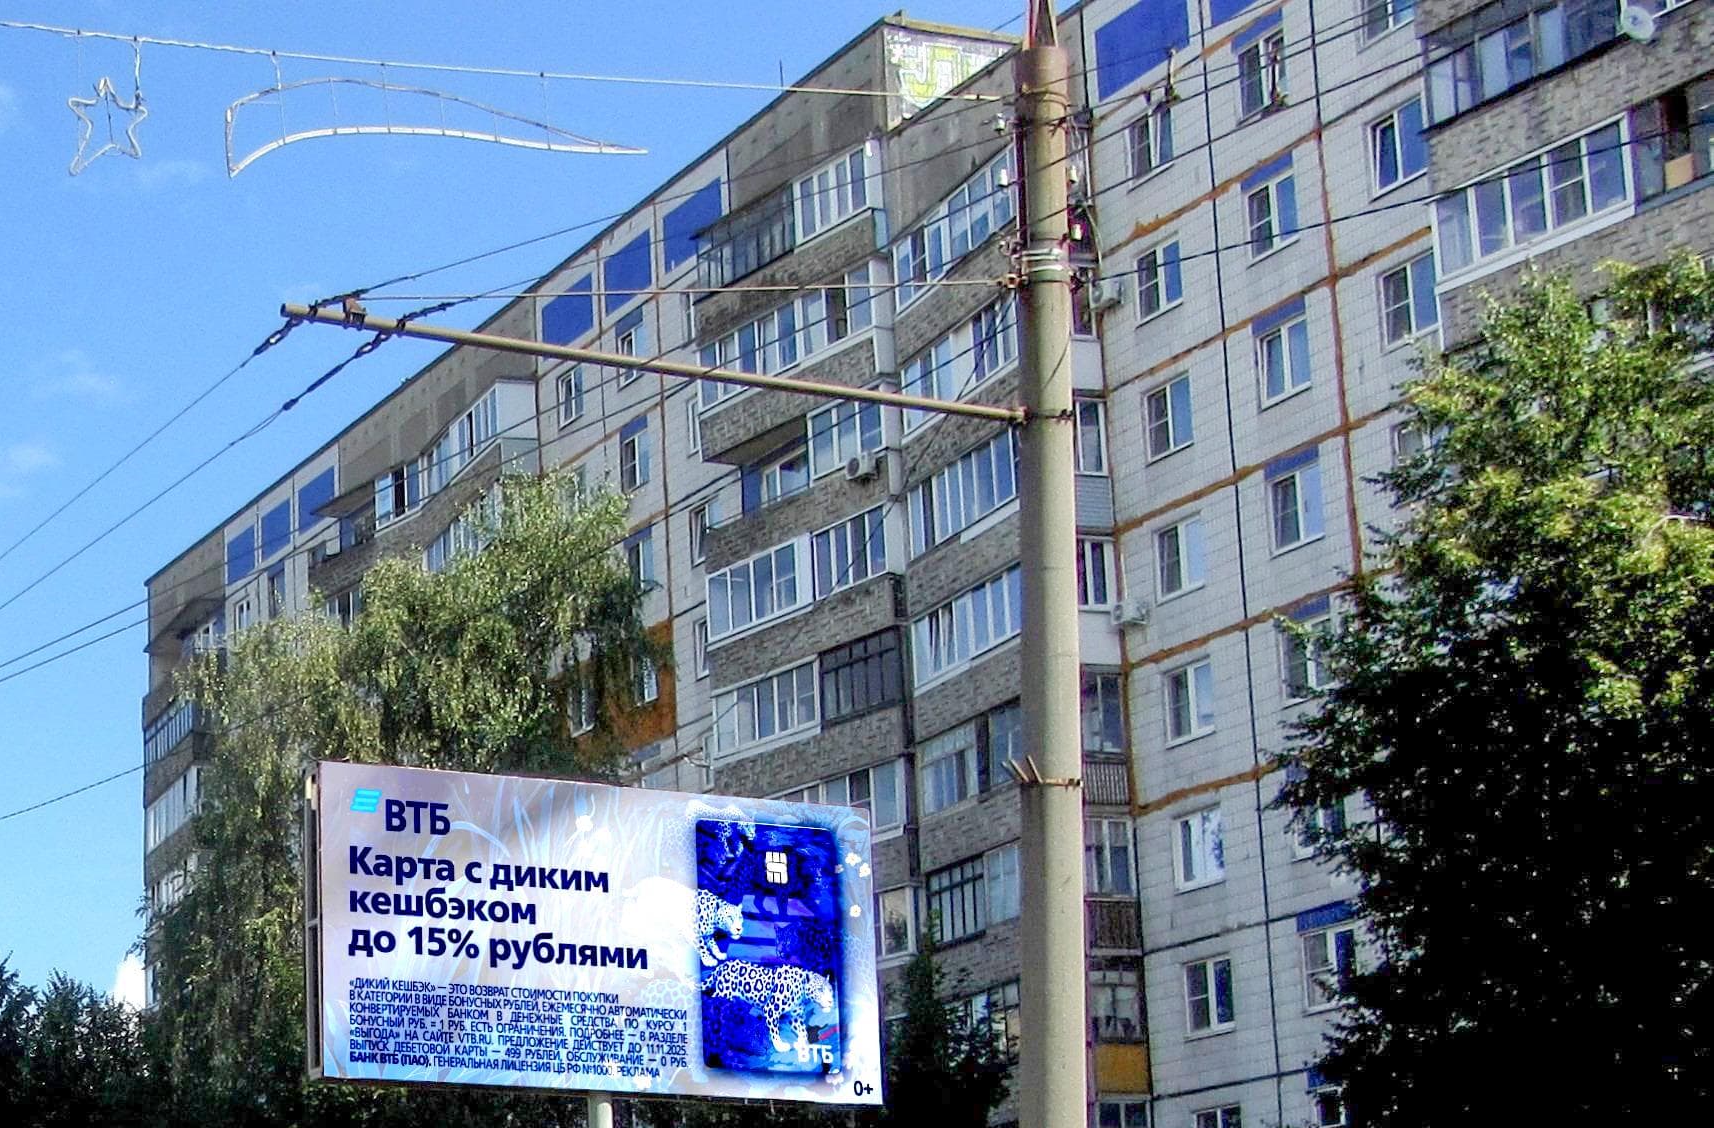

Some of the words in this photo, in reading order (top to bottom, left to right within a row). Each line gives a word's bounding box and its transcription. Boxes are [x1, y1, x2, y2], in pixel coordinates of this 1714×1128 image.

[385, 798, 451, 836] ВТБ
[349, 845, 455, 886] Карта
[464, 861, 482, 884] с
[489, 863, 609, 894] диким
[349, 887, 536, 926] кешбэком
[348, 928, 396, 958] до
[407, 926, 480, 959] 15%
[489, 932, 648, 970] рублями
[349, 976, 389, 989] «ДИКИЙ
[392, 981, 436, 992] КЕШБЭК»
[448, 985, 467, 993] ЭТО
[469, 986, 509, 996] ВОЗВРАТ
[510, 989, 571, 1001] СТОИМОСТИ
[573, 992, 618, 1003] ПОКУПКИ
[349, 990, 355, 999] В
[357, 991, 412, 1002] КАТЕГОРИИ
[414, 994, 420, 1003] В
[422, 995, 446, 1006] ВИДЕ
[448, 996, 501, 1008] БОНУСНЫХ
[541, 1002, 606, 1014] ЕЖЕМЕСЯЧНО
[608, 1006, 686, 1019] АВТОМАТИЧЕСКИ
[349, 1003, 440, 1017] КОНВЕРТИРУЕМЫХ
[447, 1009, 488, 1019] БАНКОМ
[496, 1011, 502, 1020] В
[509, 1013, 562, 1025] ДЕНЕЖНЫЕ
[570, 1016, 617, 1027] СРЕДСТВА
[624, 1018, 638, 1028] ПО
[646, 1021, 675, 1030] КУРСУ
[683, 1022, 686, 1030] 1
[349, 1015, 404, 1027] БОНУСНЫЙ
[408, 1019, 427, 1028] РУБ.
[440, 1020, 443, 1028] 1
[448, 1021, 467, 1030] РУБ.
[470, 1023, 493, 1032] ЕСТЬ
[496, 1024, 566, 1036] ОГРАНИЧЕНИЯ.
[569, 1028, 624, 1040] ПОДРОБНЕЕ
[639, 1032, 645, 1040] В
[648, 1033, 687, 1044] РАЗДЕЛЕ
[349, 1028, 400, 1039] «ВЫГОДА»
[404, 1030, 419, 1039] НА
[422, 1030, 454, 1042] САЙТЕ
[498, 1036, 568, 1049] ПРЕДЛОЖЕНИЕ
[572, 1040, 623, 1052] ДЕЙСТВУЕТ
[627, 1043, 641, 1053] ДО
[349, 1040, 389, 1050] ВЫПУСК
[393, 1043, 449, 1055] ДЕБЕТОВОЙ
[454, 1046, 487, 1056] КАРТЫ
[504, 1048, 521, 1057] 499
[660, 1057, 666, 1065] 0
[670, 1057, 688, 1066] РУБ.
[349, 1053, 378, 1062] БАНК
[379, 1054, 399, 1063] ВТБ
[433, 1057, 498, 1069] ГЕНЕРАЛЬНАЯ
[501, 1061, 550, 1072] ЛИЦЕНЗИЯ
[553, 1063, 565, 1073] ЦБ
[567, 1064, 580, 1072] РФ
[798, 1044, 834, 1064] ВТБ
[853, 1080, 874, 1096] 0+
